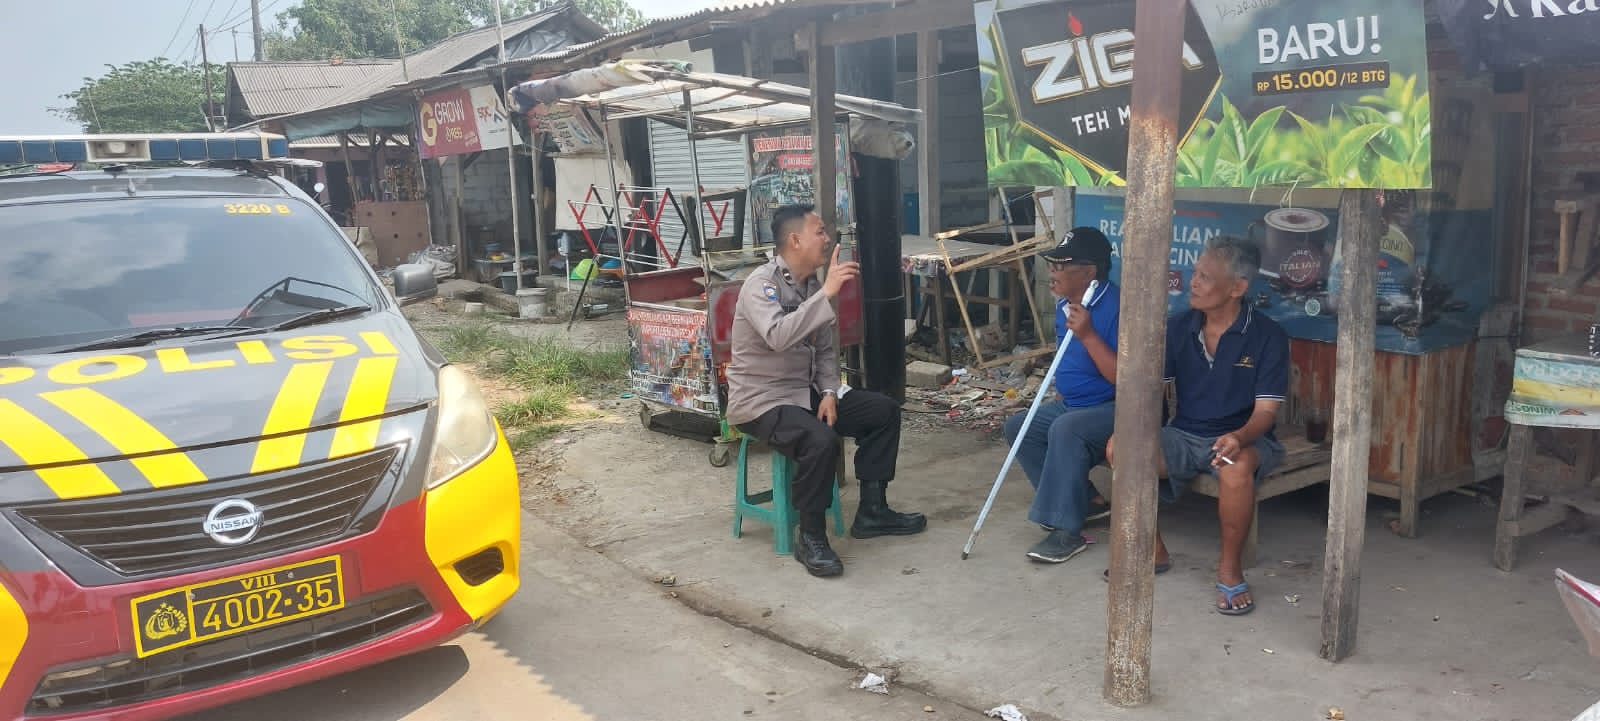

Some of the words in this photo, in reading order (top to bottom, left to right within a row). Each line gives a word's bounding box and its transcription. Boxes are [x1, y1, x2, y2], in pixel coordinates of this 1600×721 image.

[1257, 15, 1382, 64] BARU!
[1256, 81, 1270, 92] RP
[1272, 69, 1337, 91] 15.000
[1362, 70, 1386, 83] BTG
[434, 98, 465, 125] GROW
[1072, 111, 1110, 136] TEH
[1118, 104, 1131, 126] M
[223, 203, 272, 215] 3220
[276, 204, 291, 215] B
[1100, 219, 1125, 237] REA
[210, 516, 257, 530] NISSAN
[239, 573, 277, 591] VIII
